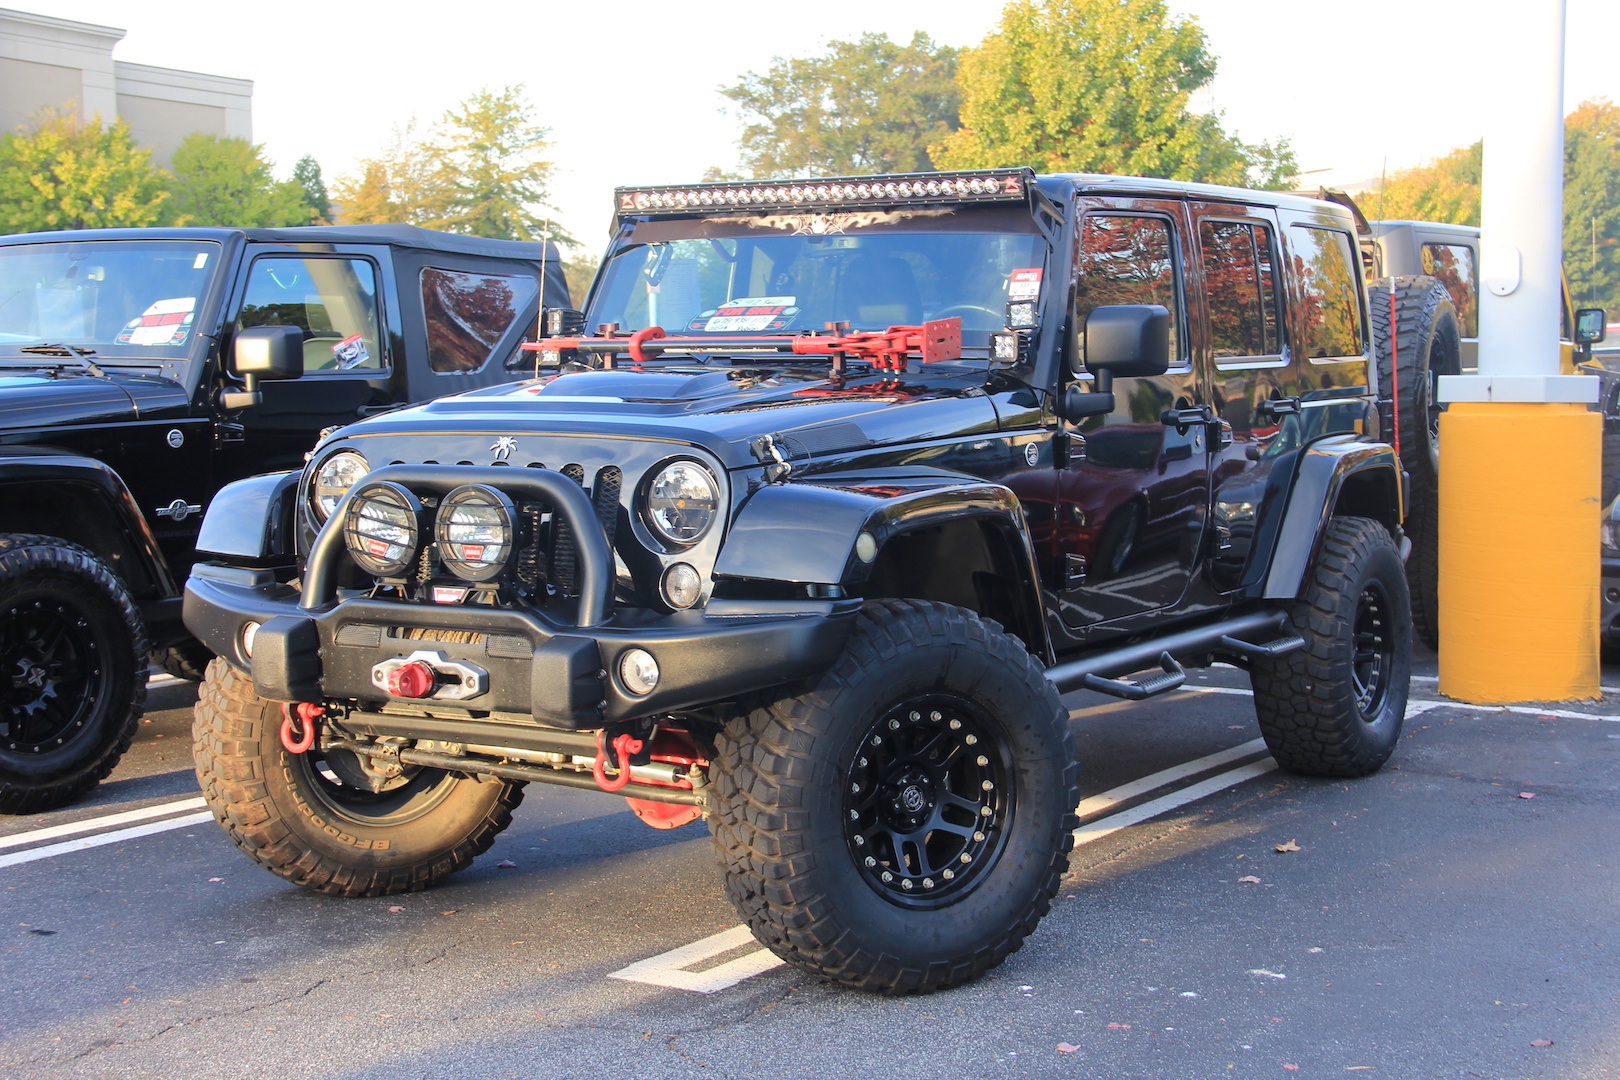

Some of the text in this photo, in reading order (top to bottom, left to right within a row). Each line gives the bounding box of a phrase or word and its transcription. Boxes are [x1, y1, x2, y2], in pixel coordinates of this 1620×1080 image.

[714, 306, 787, 316] FOR SALE
[371, 543, 385, 554] WARN
